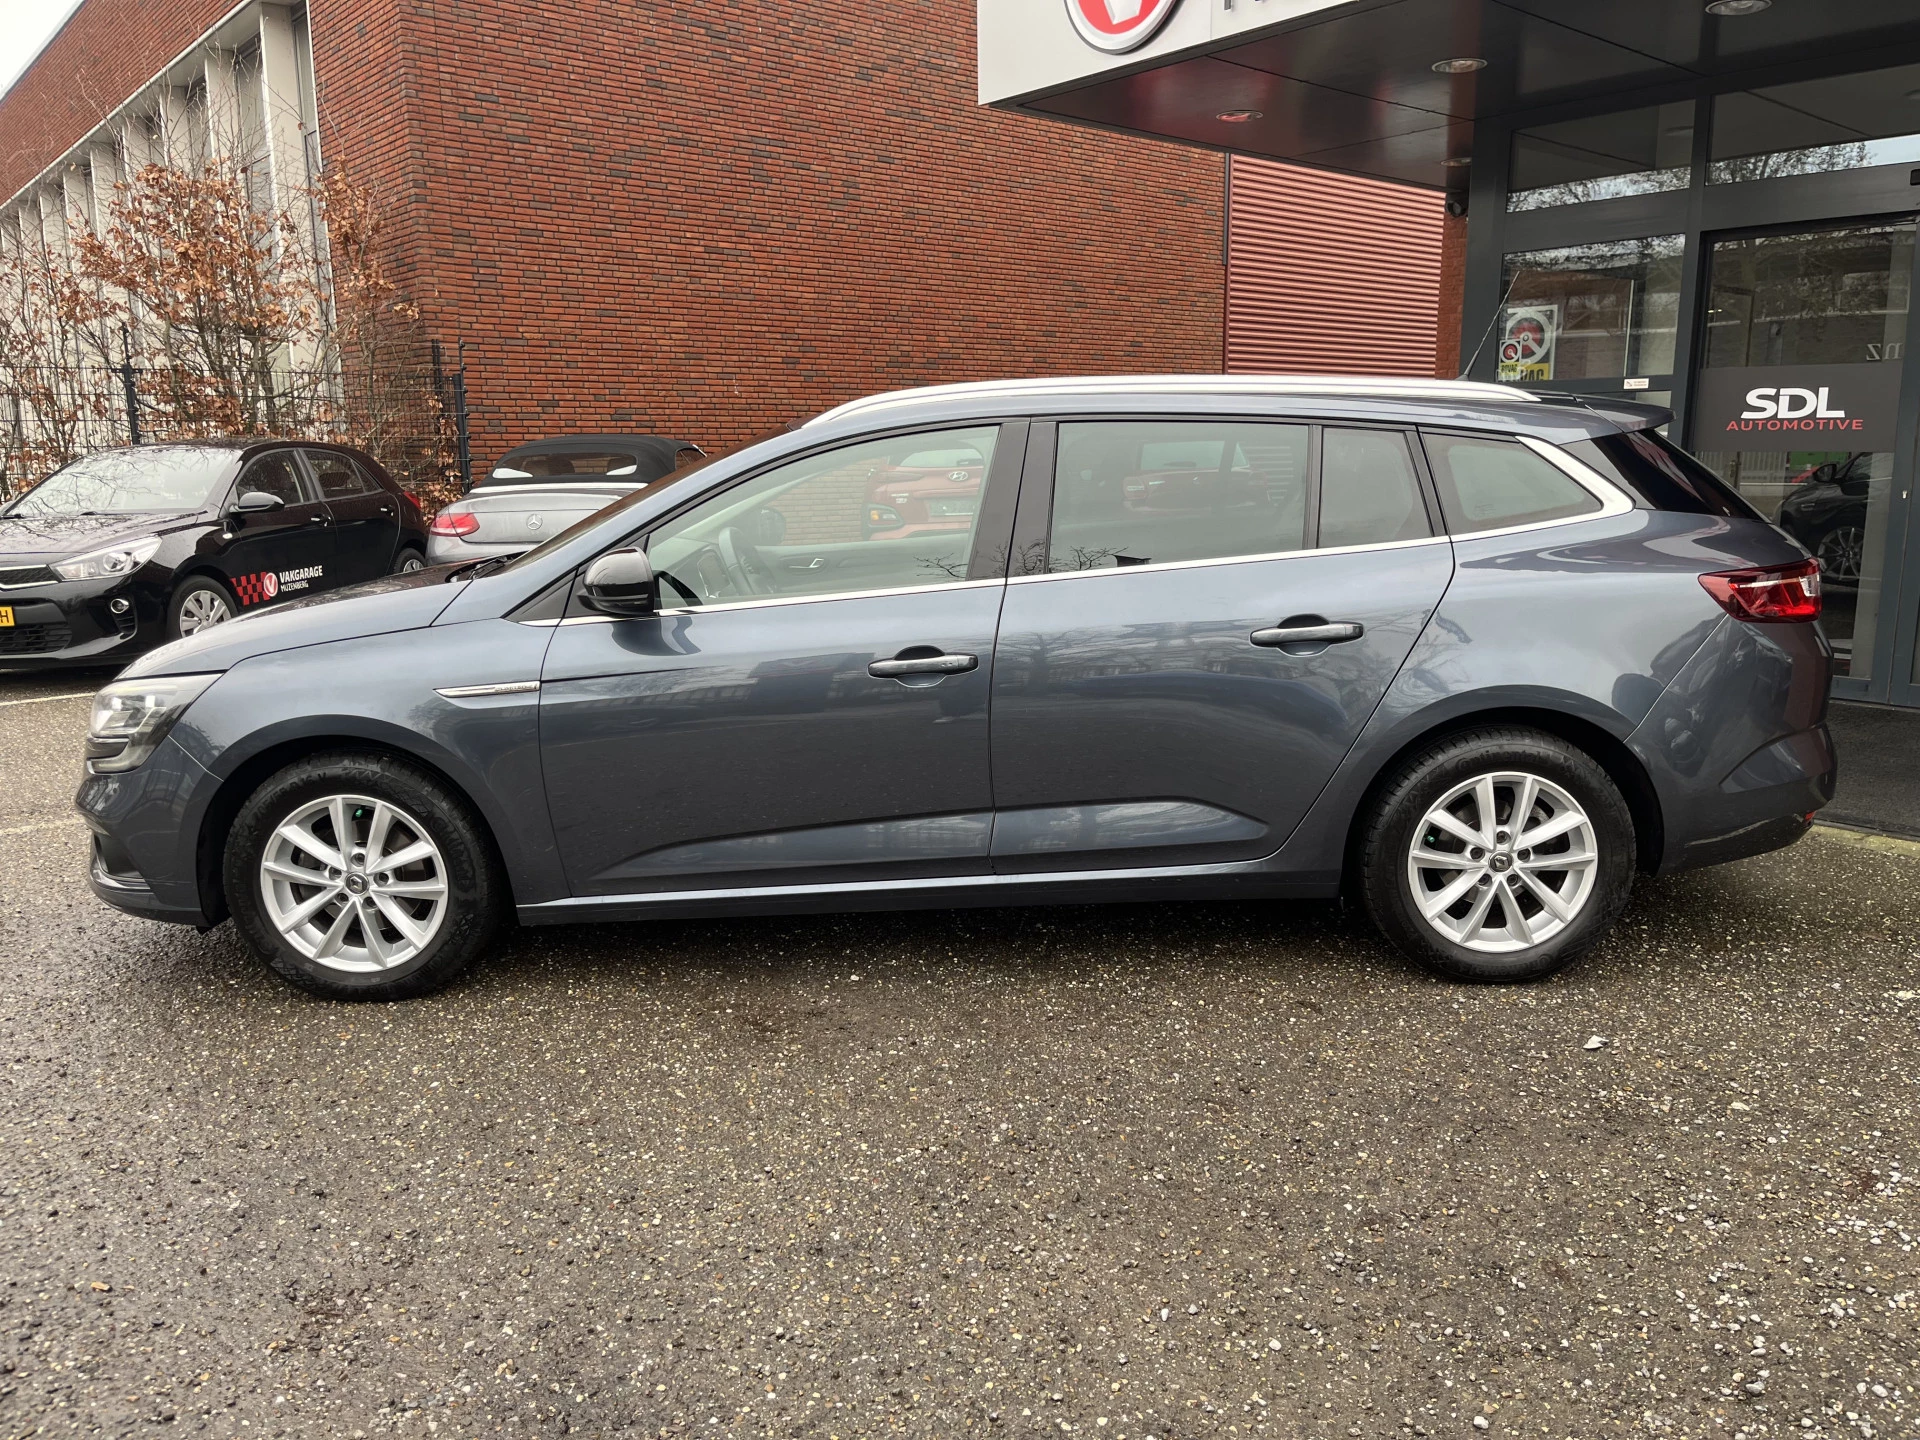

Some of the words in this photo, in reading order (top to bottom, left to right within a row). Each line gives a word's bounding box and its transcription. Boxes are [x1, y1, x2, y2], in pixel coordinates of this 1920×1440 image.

[1740, 387, 1845, 419] SDL
[1726, 419, 1864, 431] AUTOMOTIVE
[279, 565, 324, 583] VAKGARAGE
